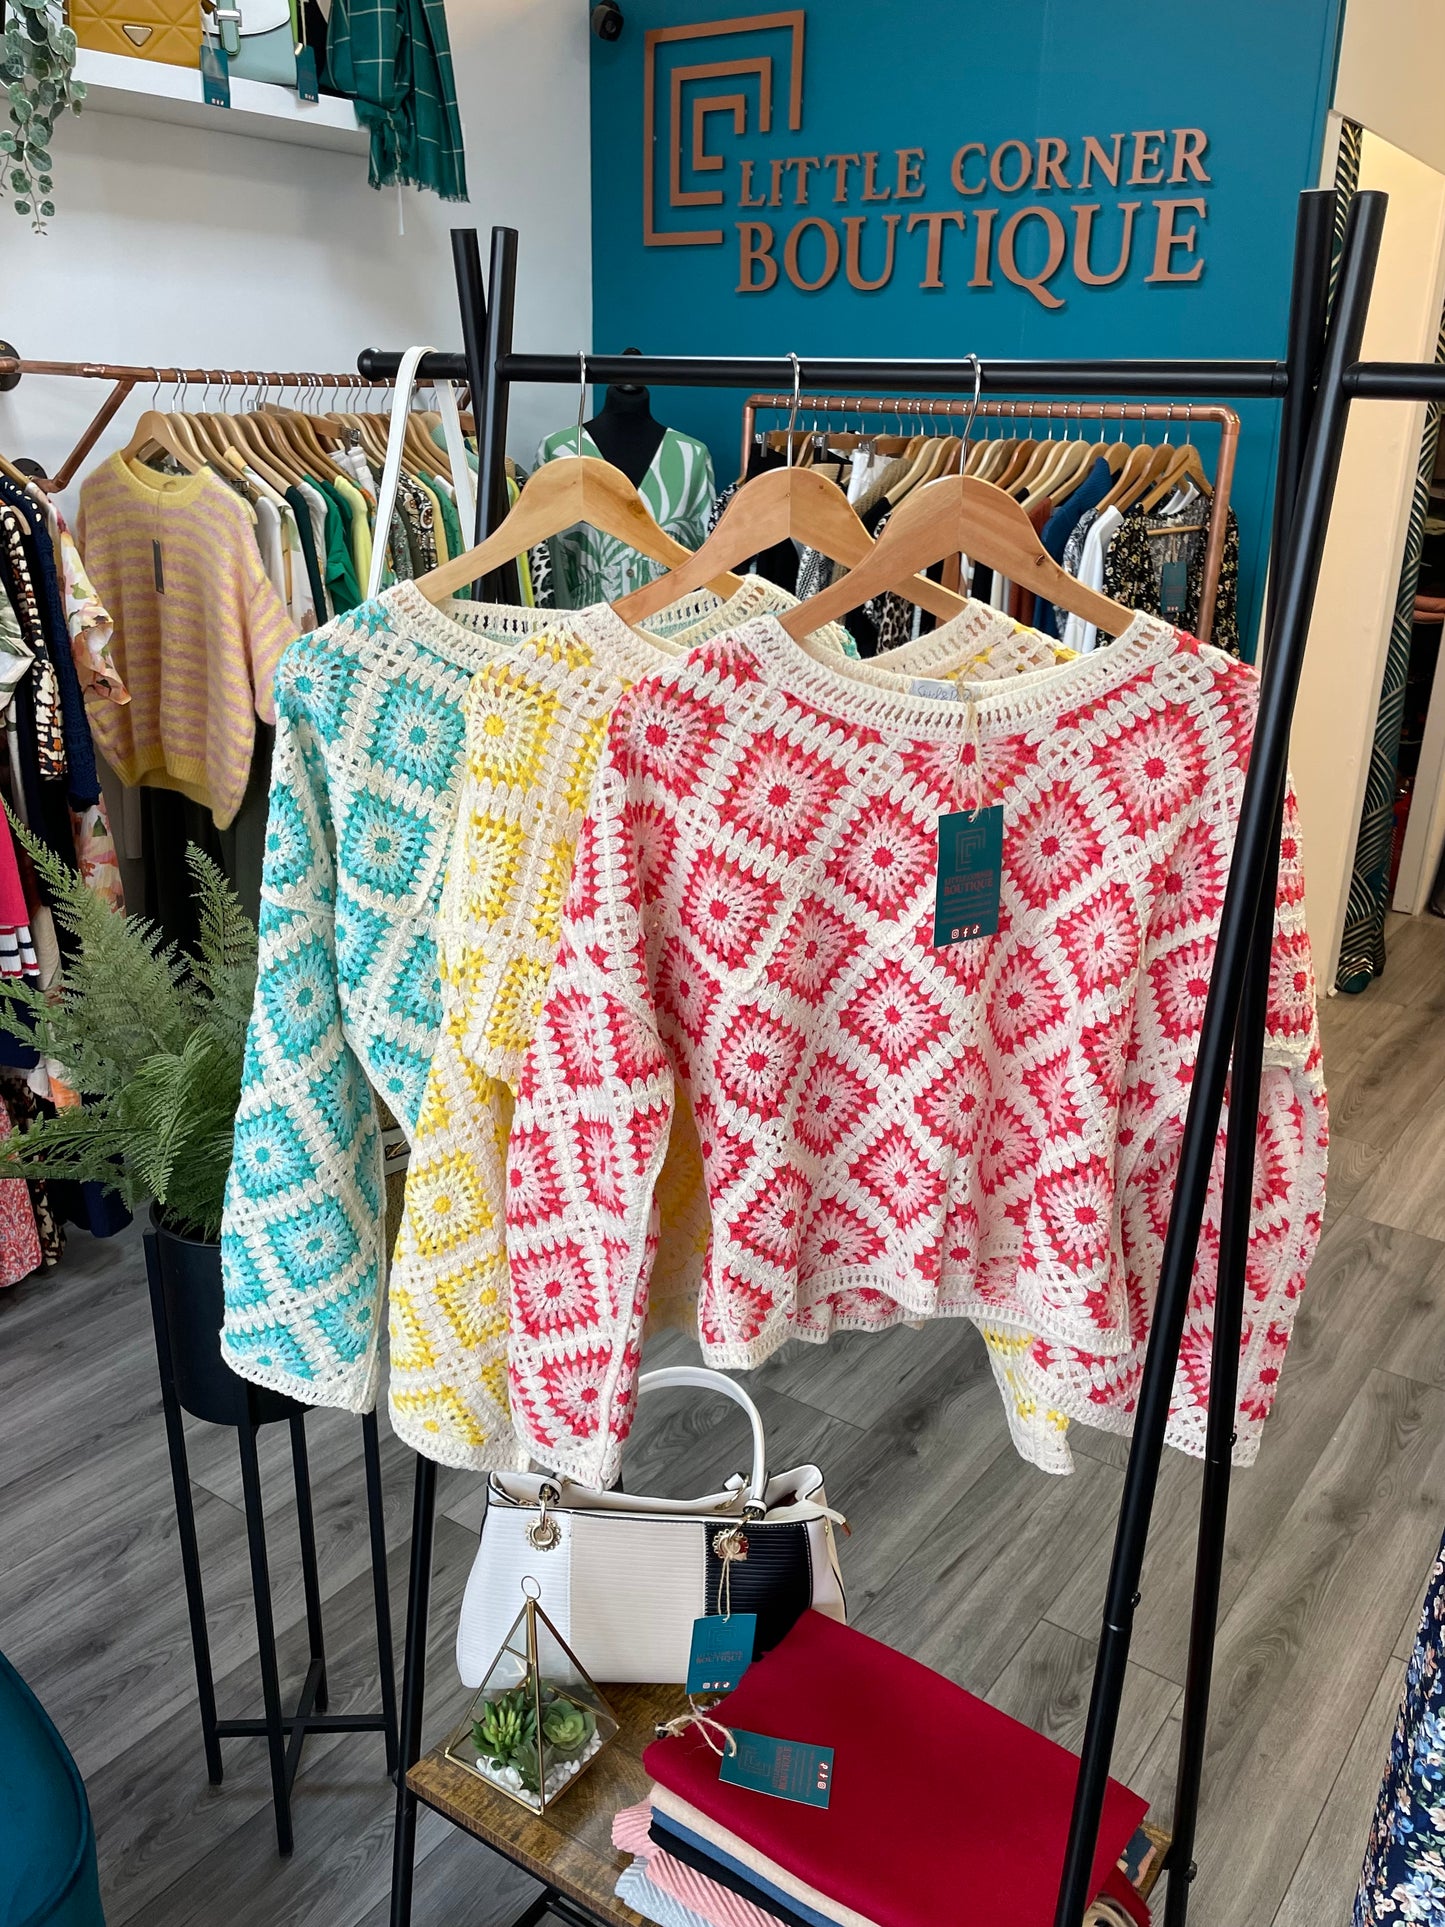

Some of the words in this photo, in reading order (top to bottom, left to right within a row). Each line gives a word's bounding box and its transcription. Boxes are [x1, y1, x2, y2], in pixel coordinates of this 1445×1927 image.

[738, 148, 926, 207] LITTLE
[951, 128, 1212, 195] CORNER
[736, 198, 1206, 309] BOUTIQUE
